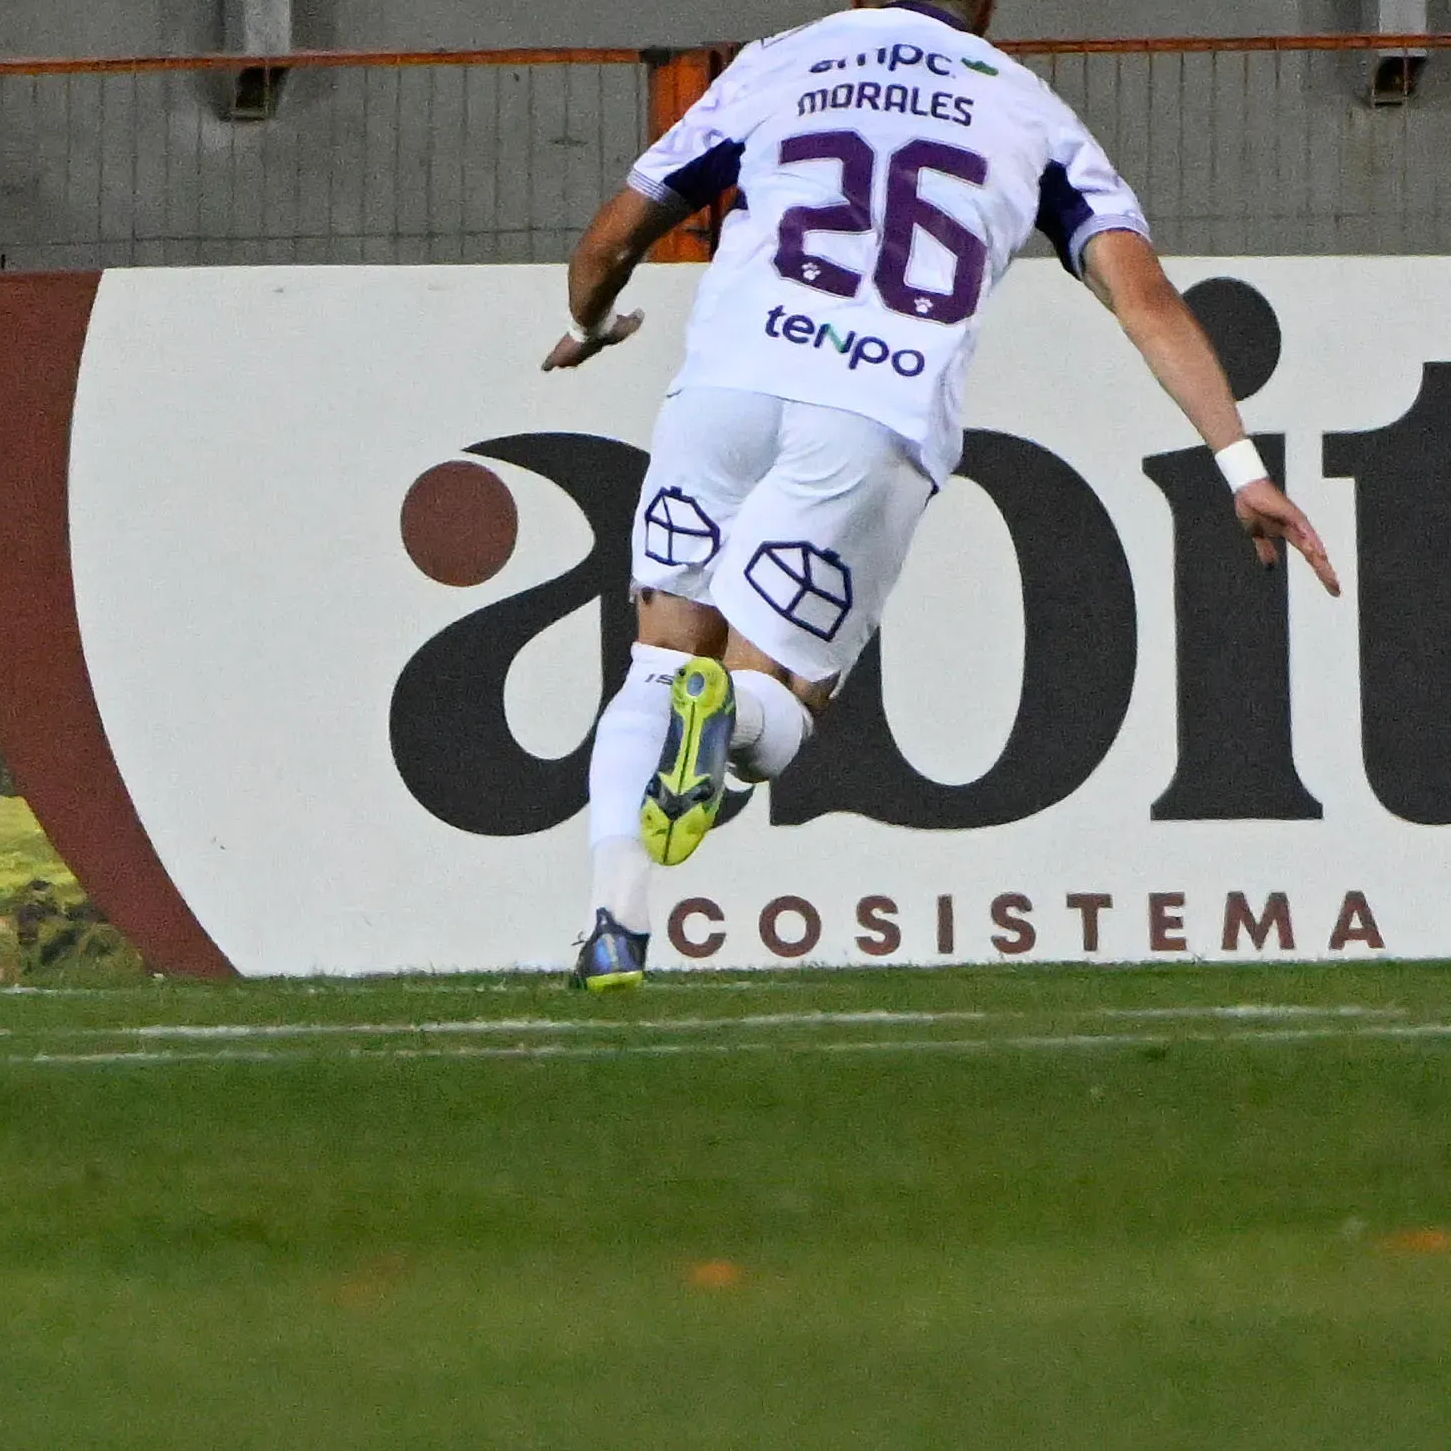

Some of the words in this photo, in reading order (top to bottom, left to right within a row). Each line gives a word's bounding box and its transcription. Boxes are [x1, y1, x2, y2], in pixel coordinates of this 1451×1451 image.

[798, 81, 974, 127] MORALES
[772, 128, 988, 326] 26
[764, 304, 926, 378] tenpo
